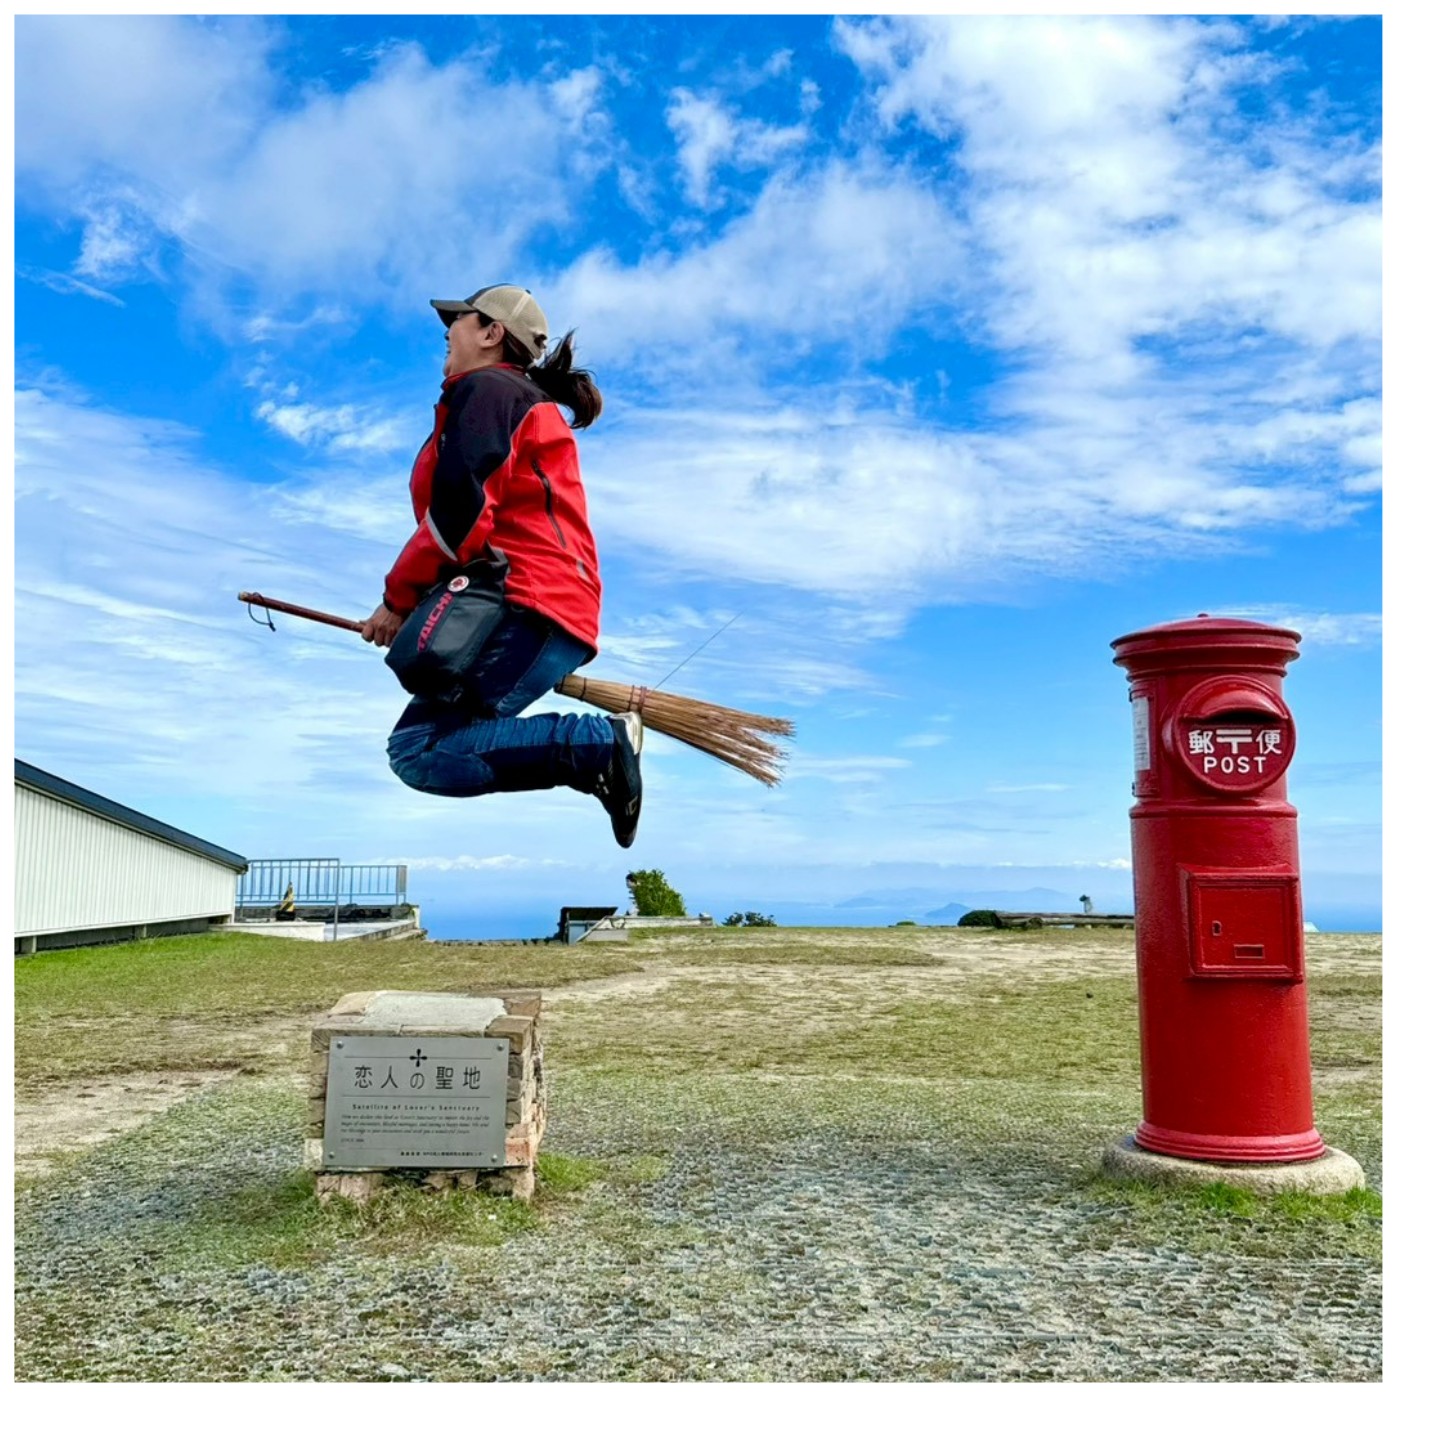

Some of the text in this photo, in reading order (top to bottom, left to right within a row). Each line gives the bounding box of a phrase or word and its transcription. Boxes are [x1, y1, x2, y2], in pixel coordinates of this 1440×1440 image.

[1203, 756, 1267, 774] POST
[353, 1065, 481, 1090] 恋人の聖地
